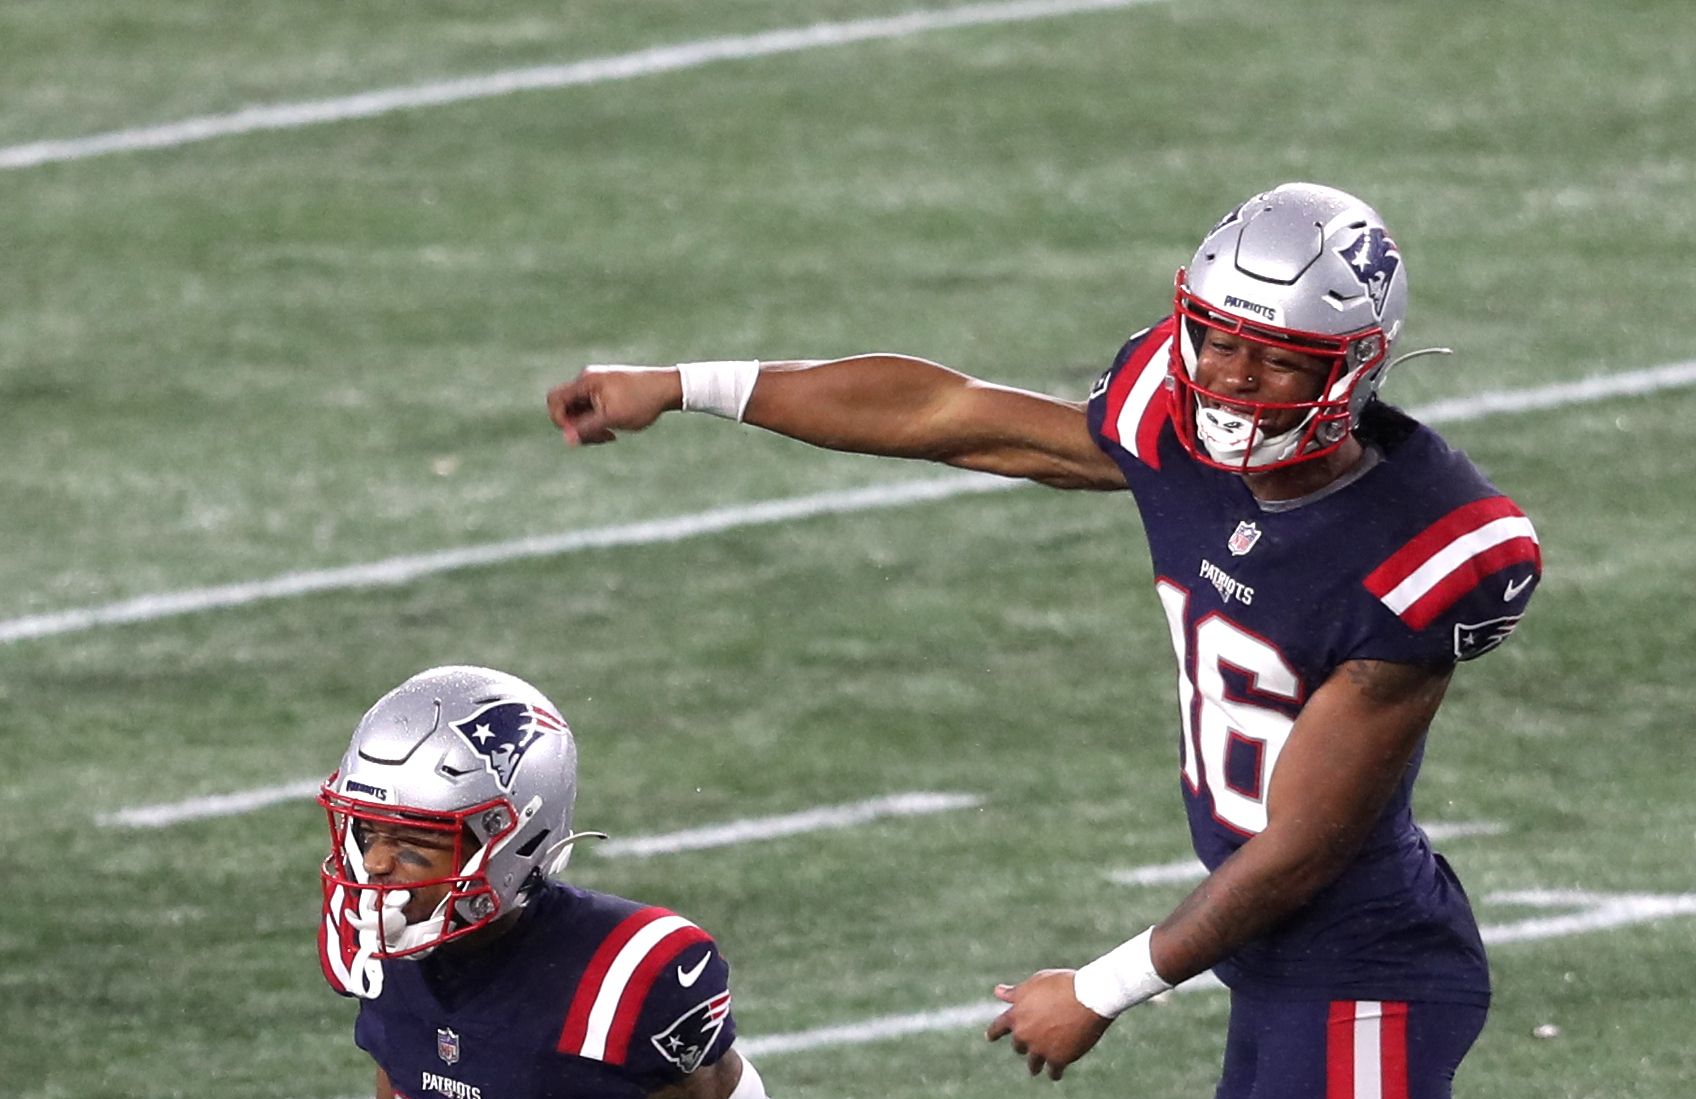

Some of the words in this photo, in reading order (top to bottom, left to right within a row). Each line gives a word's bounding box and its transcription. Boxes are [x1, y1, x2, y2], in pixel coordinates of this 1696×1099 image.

[1224, 295, 1276, 321] PATRIOTS
[1200, 559, 1254, 605] PATRIOTS
[1153, 574, 1304, 839] 16
